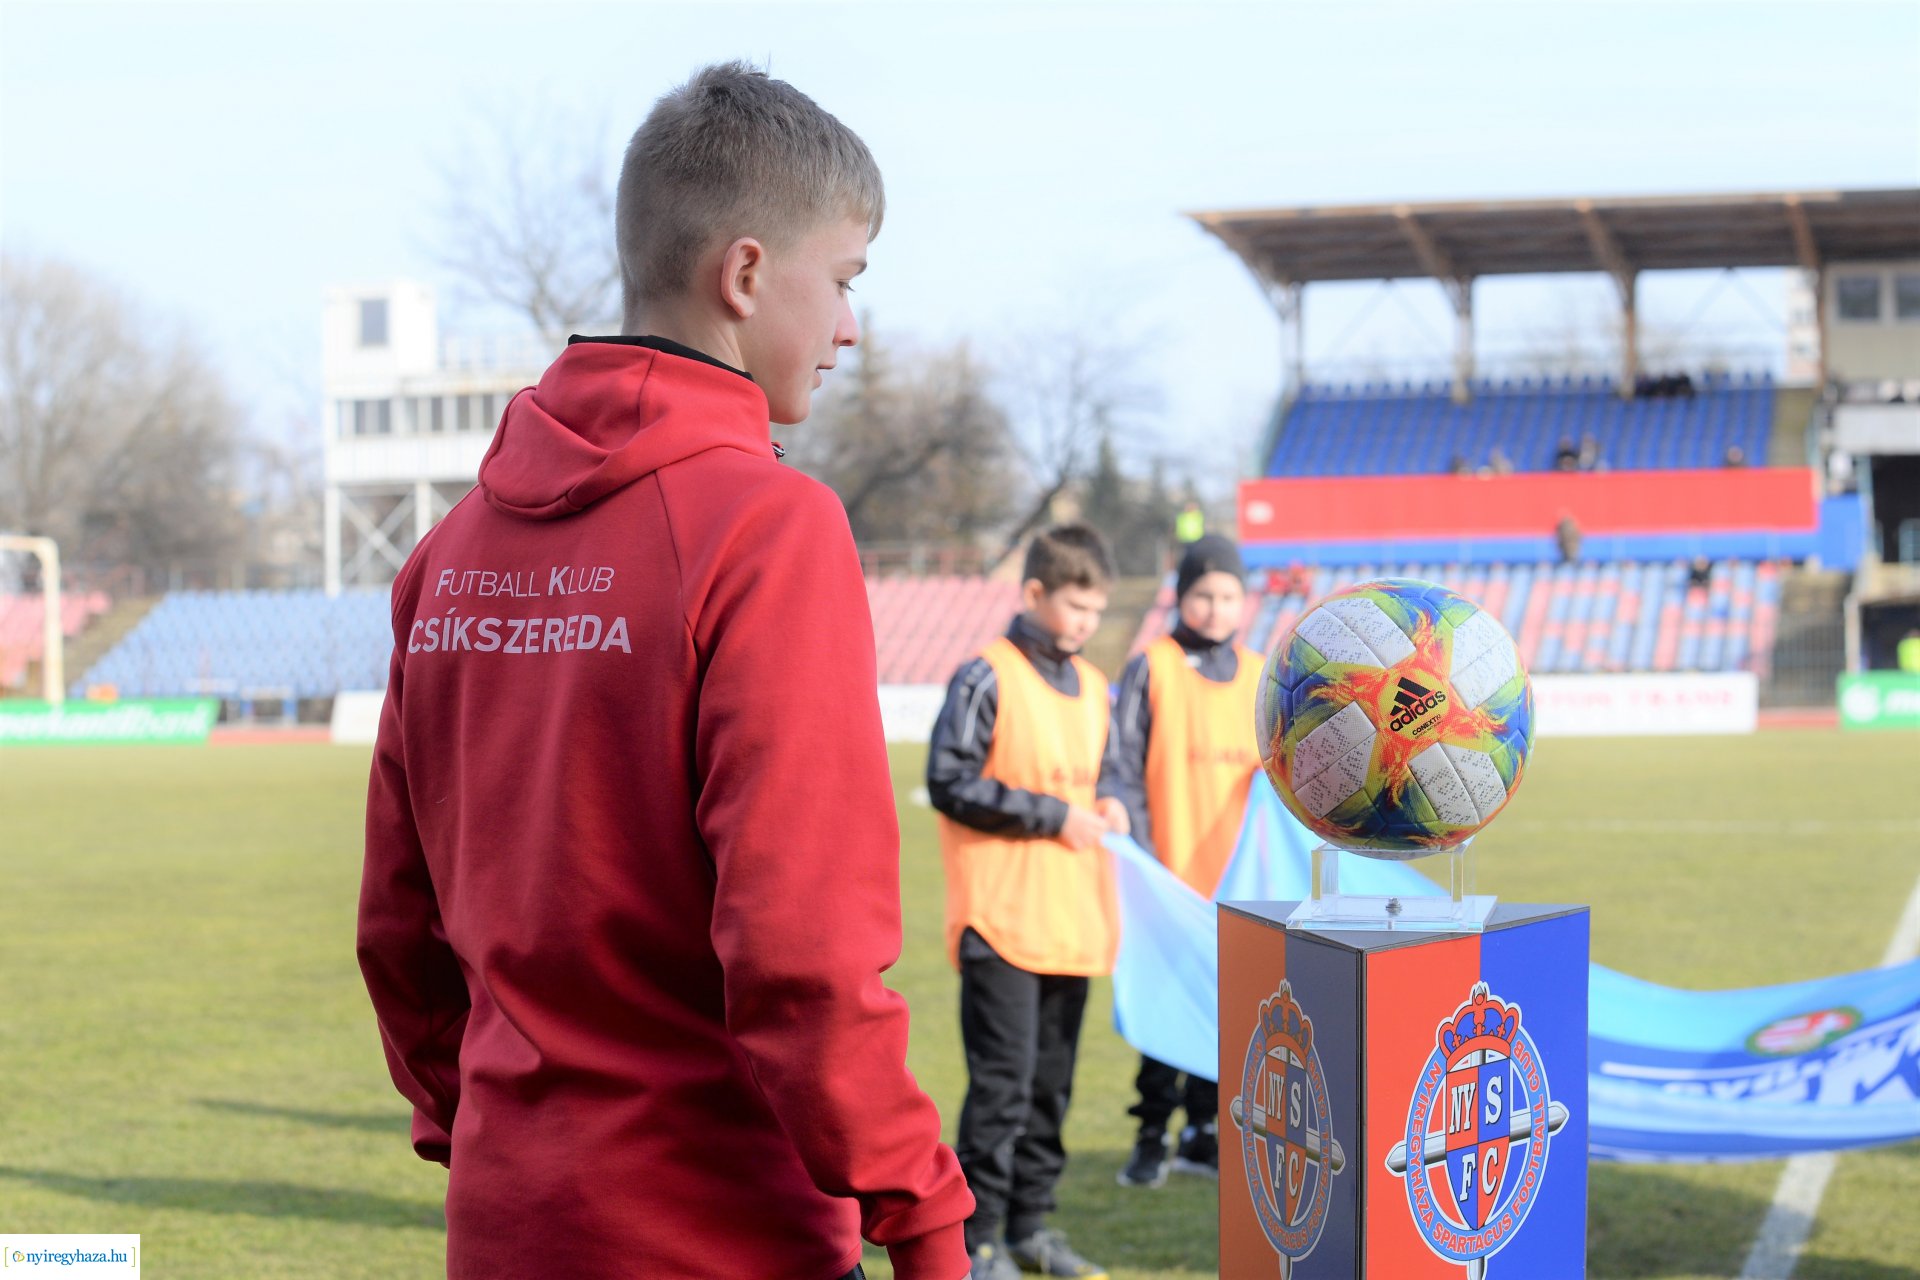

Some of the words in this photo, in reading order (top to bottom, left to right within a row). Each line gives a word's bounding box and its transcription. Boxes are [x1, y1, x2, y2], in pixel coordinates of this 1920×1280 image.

[434, 568, 540, 597] FUTBALL
[548, 566, 615, 596] KLUB
[408, 607, 632, 654] CSÍKSZEREDA
[1390, 690, 1446, 731] adidas
[1513, 1040, 1541, 1092] CLUB
[1267, 1071, 1285, 1121] NY
[1290, 1080, 1302, 1128] S
[1449, 1082, 1477, 1135] NY
[1485, 1075, 1504, 1125] S
[1274, 1143, 1286, 1190] F
[1288, 1151, 1300, 1198] C
[1409, 1061, 1443, 1229] NYÍREGYHÁZA
[1511, 1094, 1545, 1216] FOOTBALL
[1459, 1152, 1477, 1203] F
[1481, 1146, 1499, 1196] C
[1432, 1213, 1513, 1254] SPARTACUS
